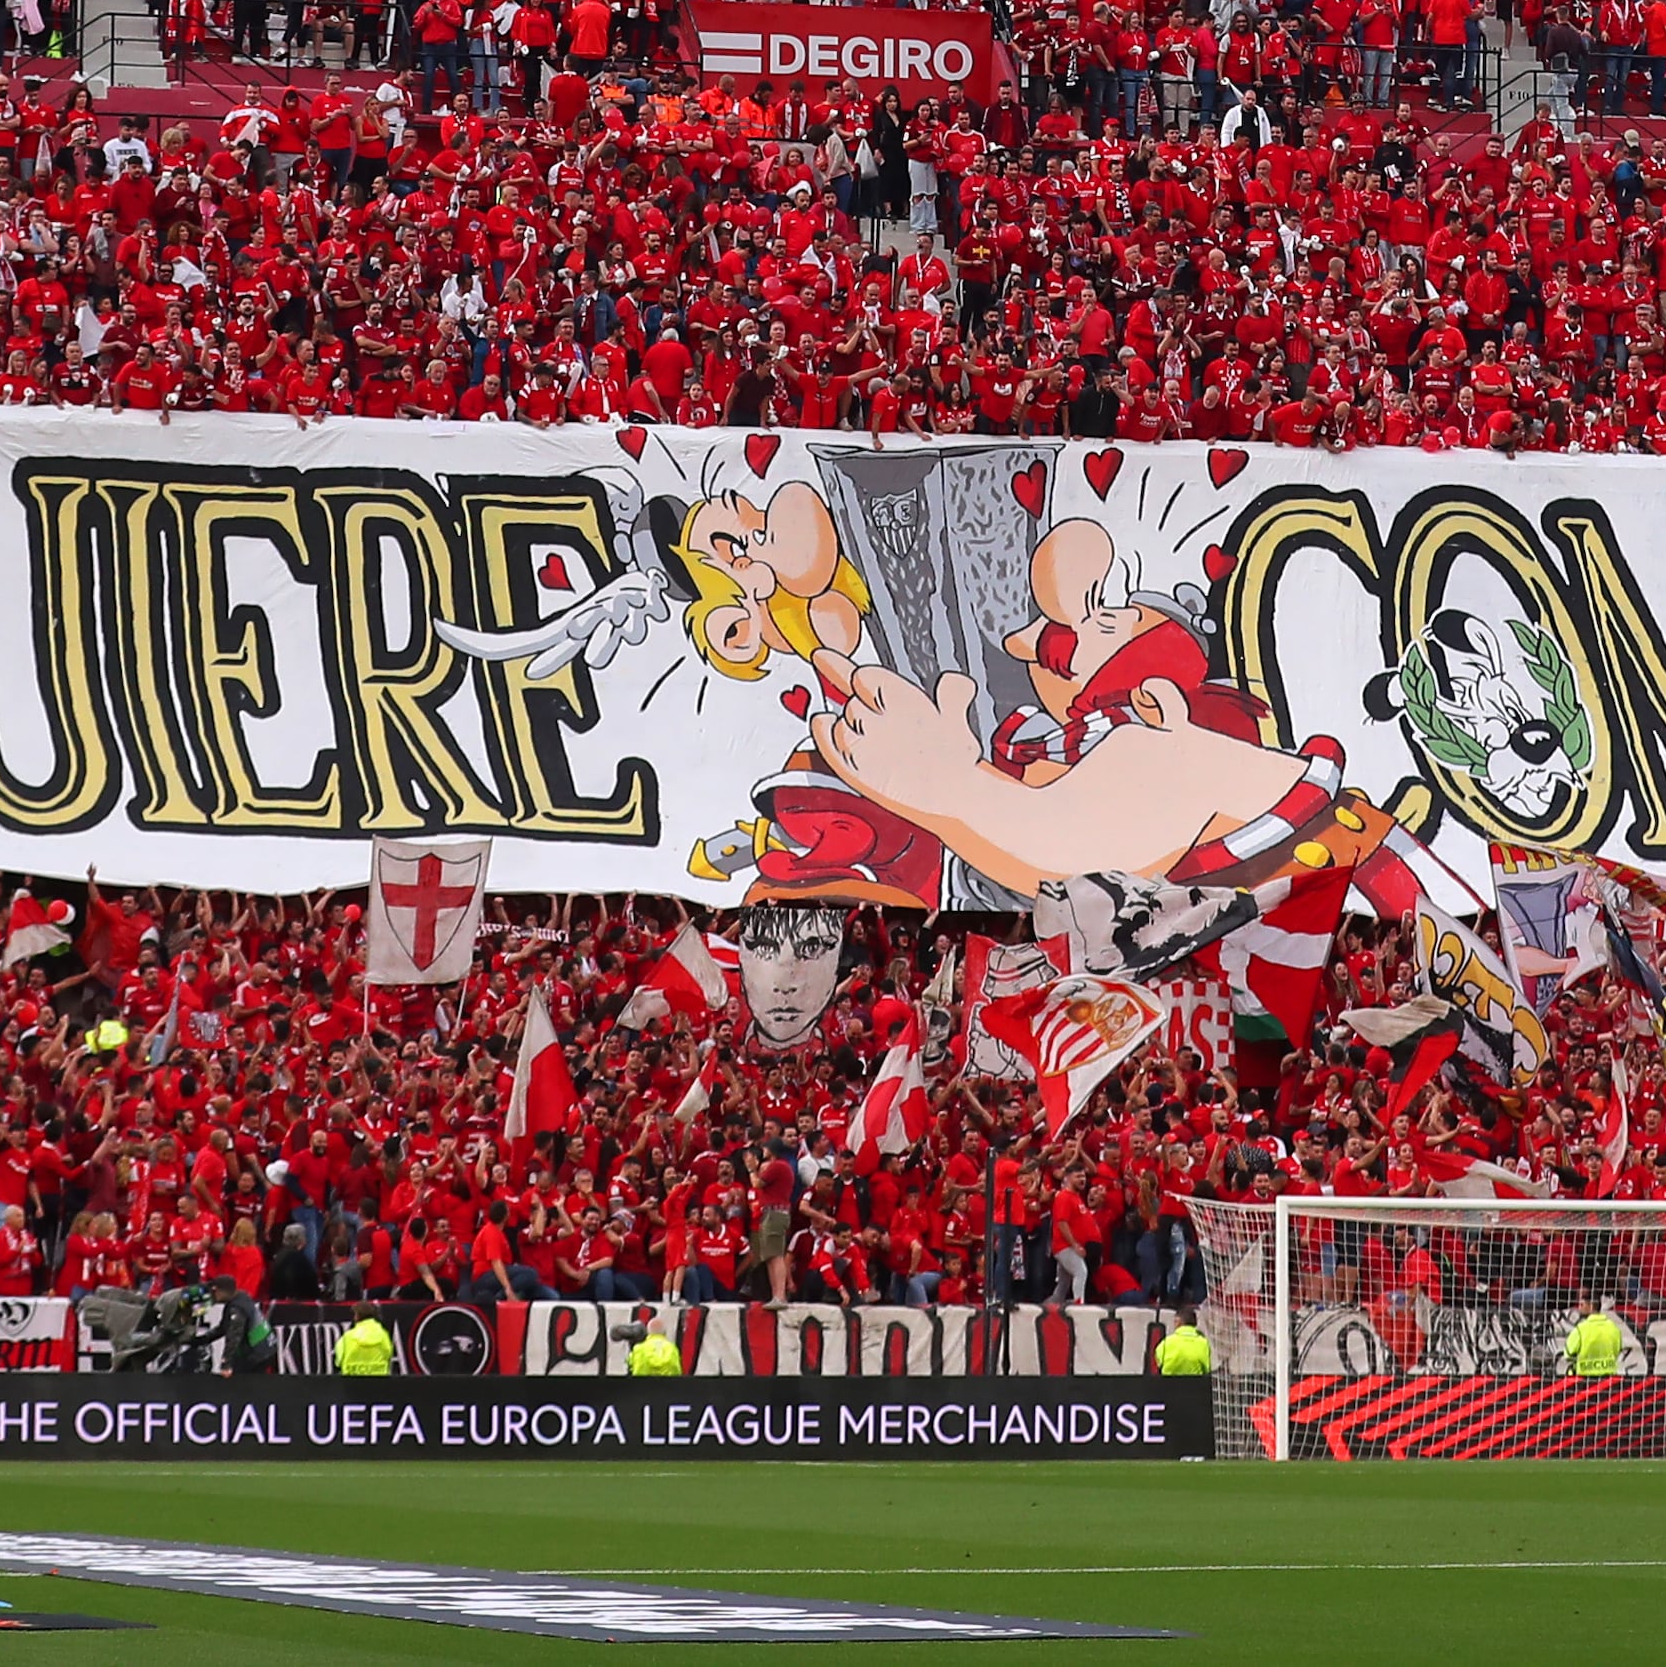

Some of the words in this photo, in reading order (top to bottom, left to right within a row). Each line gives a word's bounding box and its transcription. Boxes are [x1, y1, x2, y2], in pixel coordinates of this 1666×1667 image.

[769, 33, 974, 82] DEGIRO
[275, 1320, 409, 1375] KURA
[75, 1402, 291, 1445] OFFICIAL
[307, 1404, 426, 1446] UEFA
[442, 1403, 627, 1445] EUROPA
[641, 1403, 821, 1445] LEAGUE
[837, 1403, 1166, 1446] MERCHANDISE
